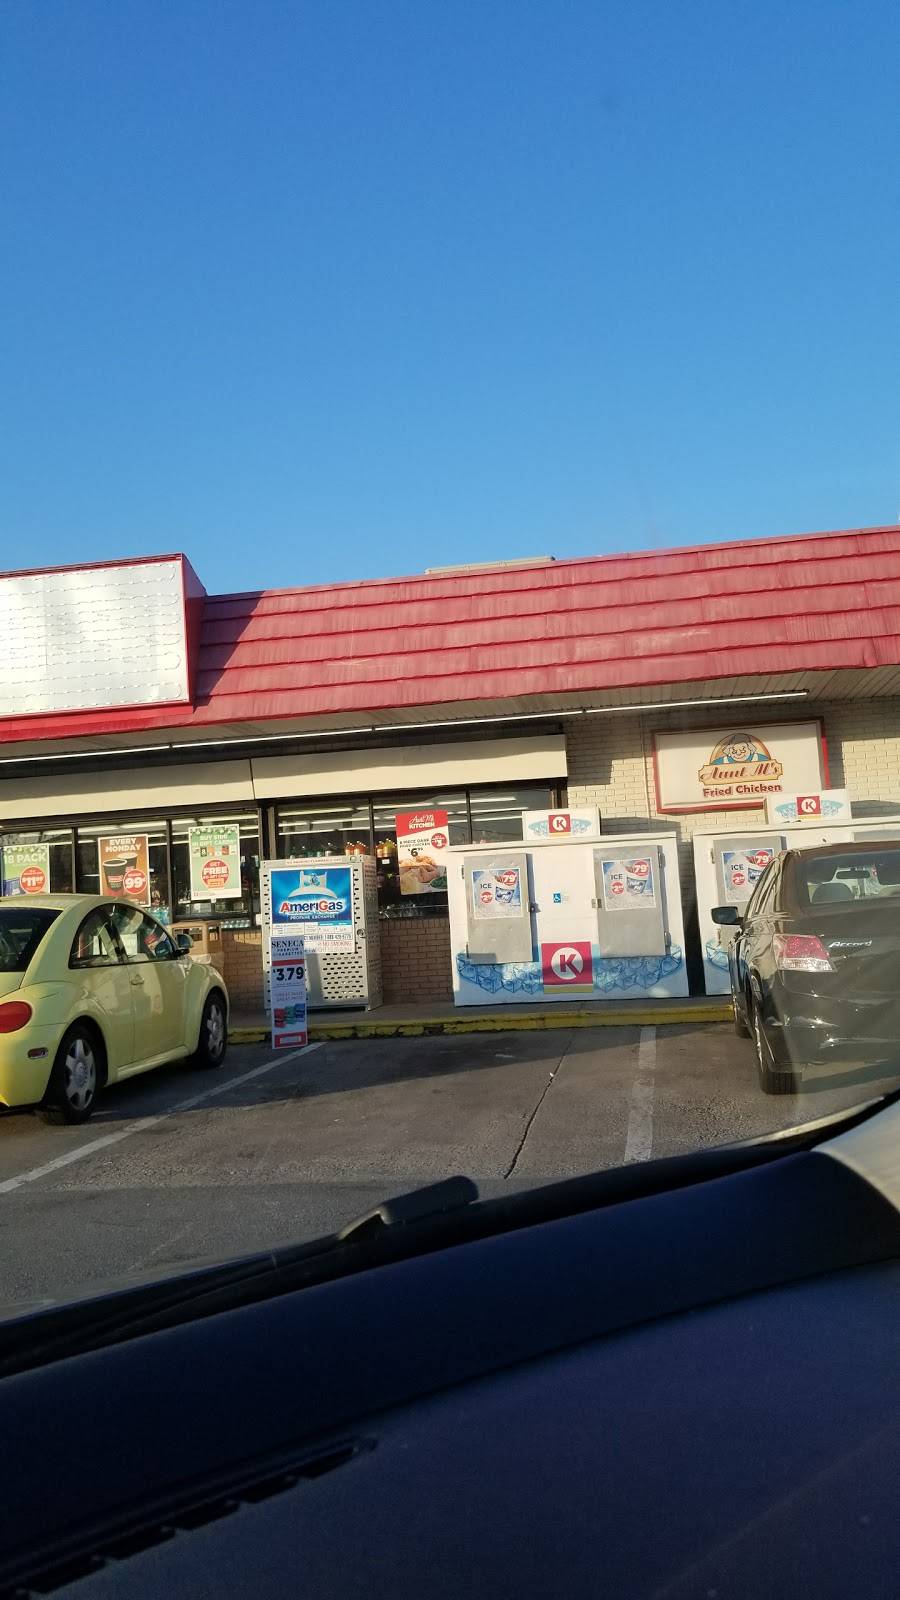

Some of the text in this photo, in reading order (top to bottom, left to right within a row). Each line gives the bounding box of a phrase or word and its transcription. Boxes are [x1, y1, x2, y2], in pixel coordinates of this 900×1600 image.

[703, 783, 782, 797] Fried Chicken
[409, 821, 436, 830] KITCHEN
[109, 837, 137, 846] EVERY
[105, 844, 142, 853] MONDAY
[16, 852, 48, 864] PACK
[203, 866, 228, 875] FREE
[280, 900, 343, 913] AmeriGas
[271, 939, 304, 949] SENECA
